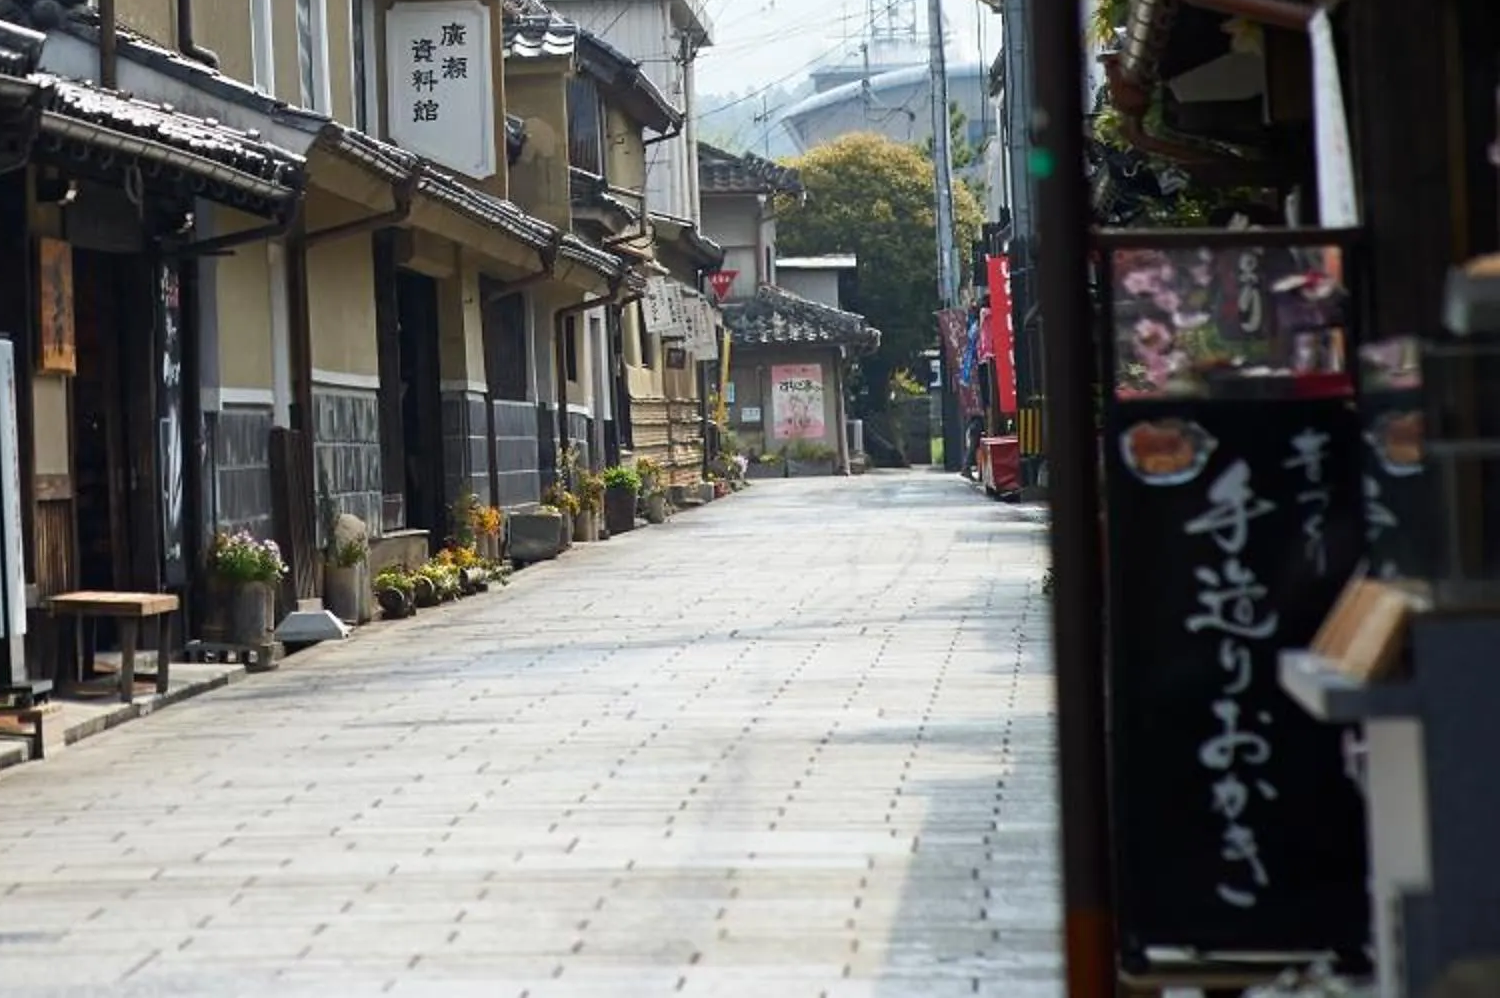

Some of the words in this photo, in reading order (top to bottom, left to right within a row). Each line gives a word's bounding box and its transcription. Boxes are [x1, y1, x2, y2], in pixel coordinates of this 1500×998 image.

[411, 38, 440, 123] 資料館
[1183, 457, 1280, 910] 手造りおかき
